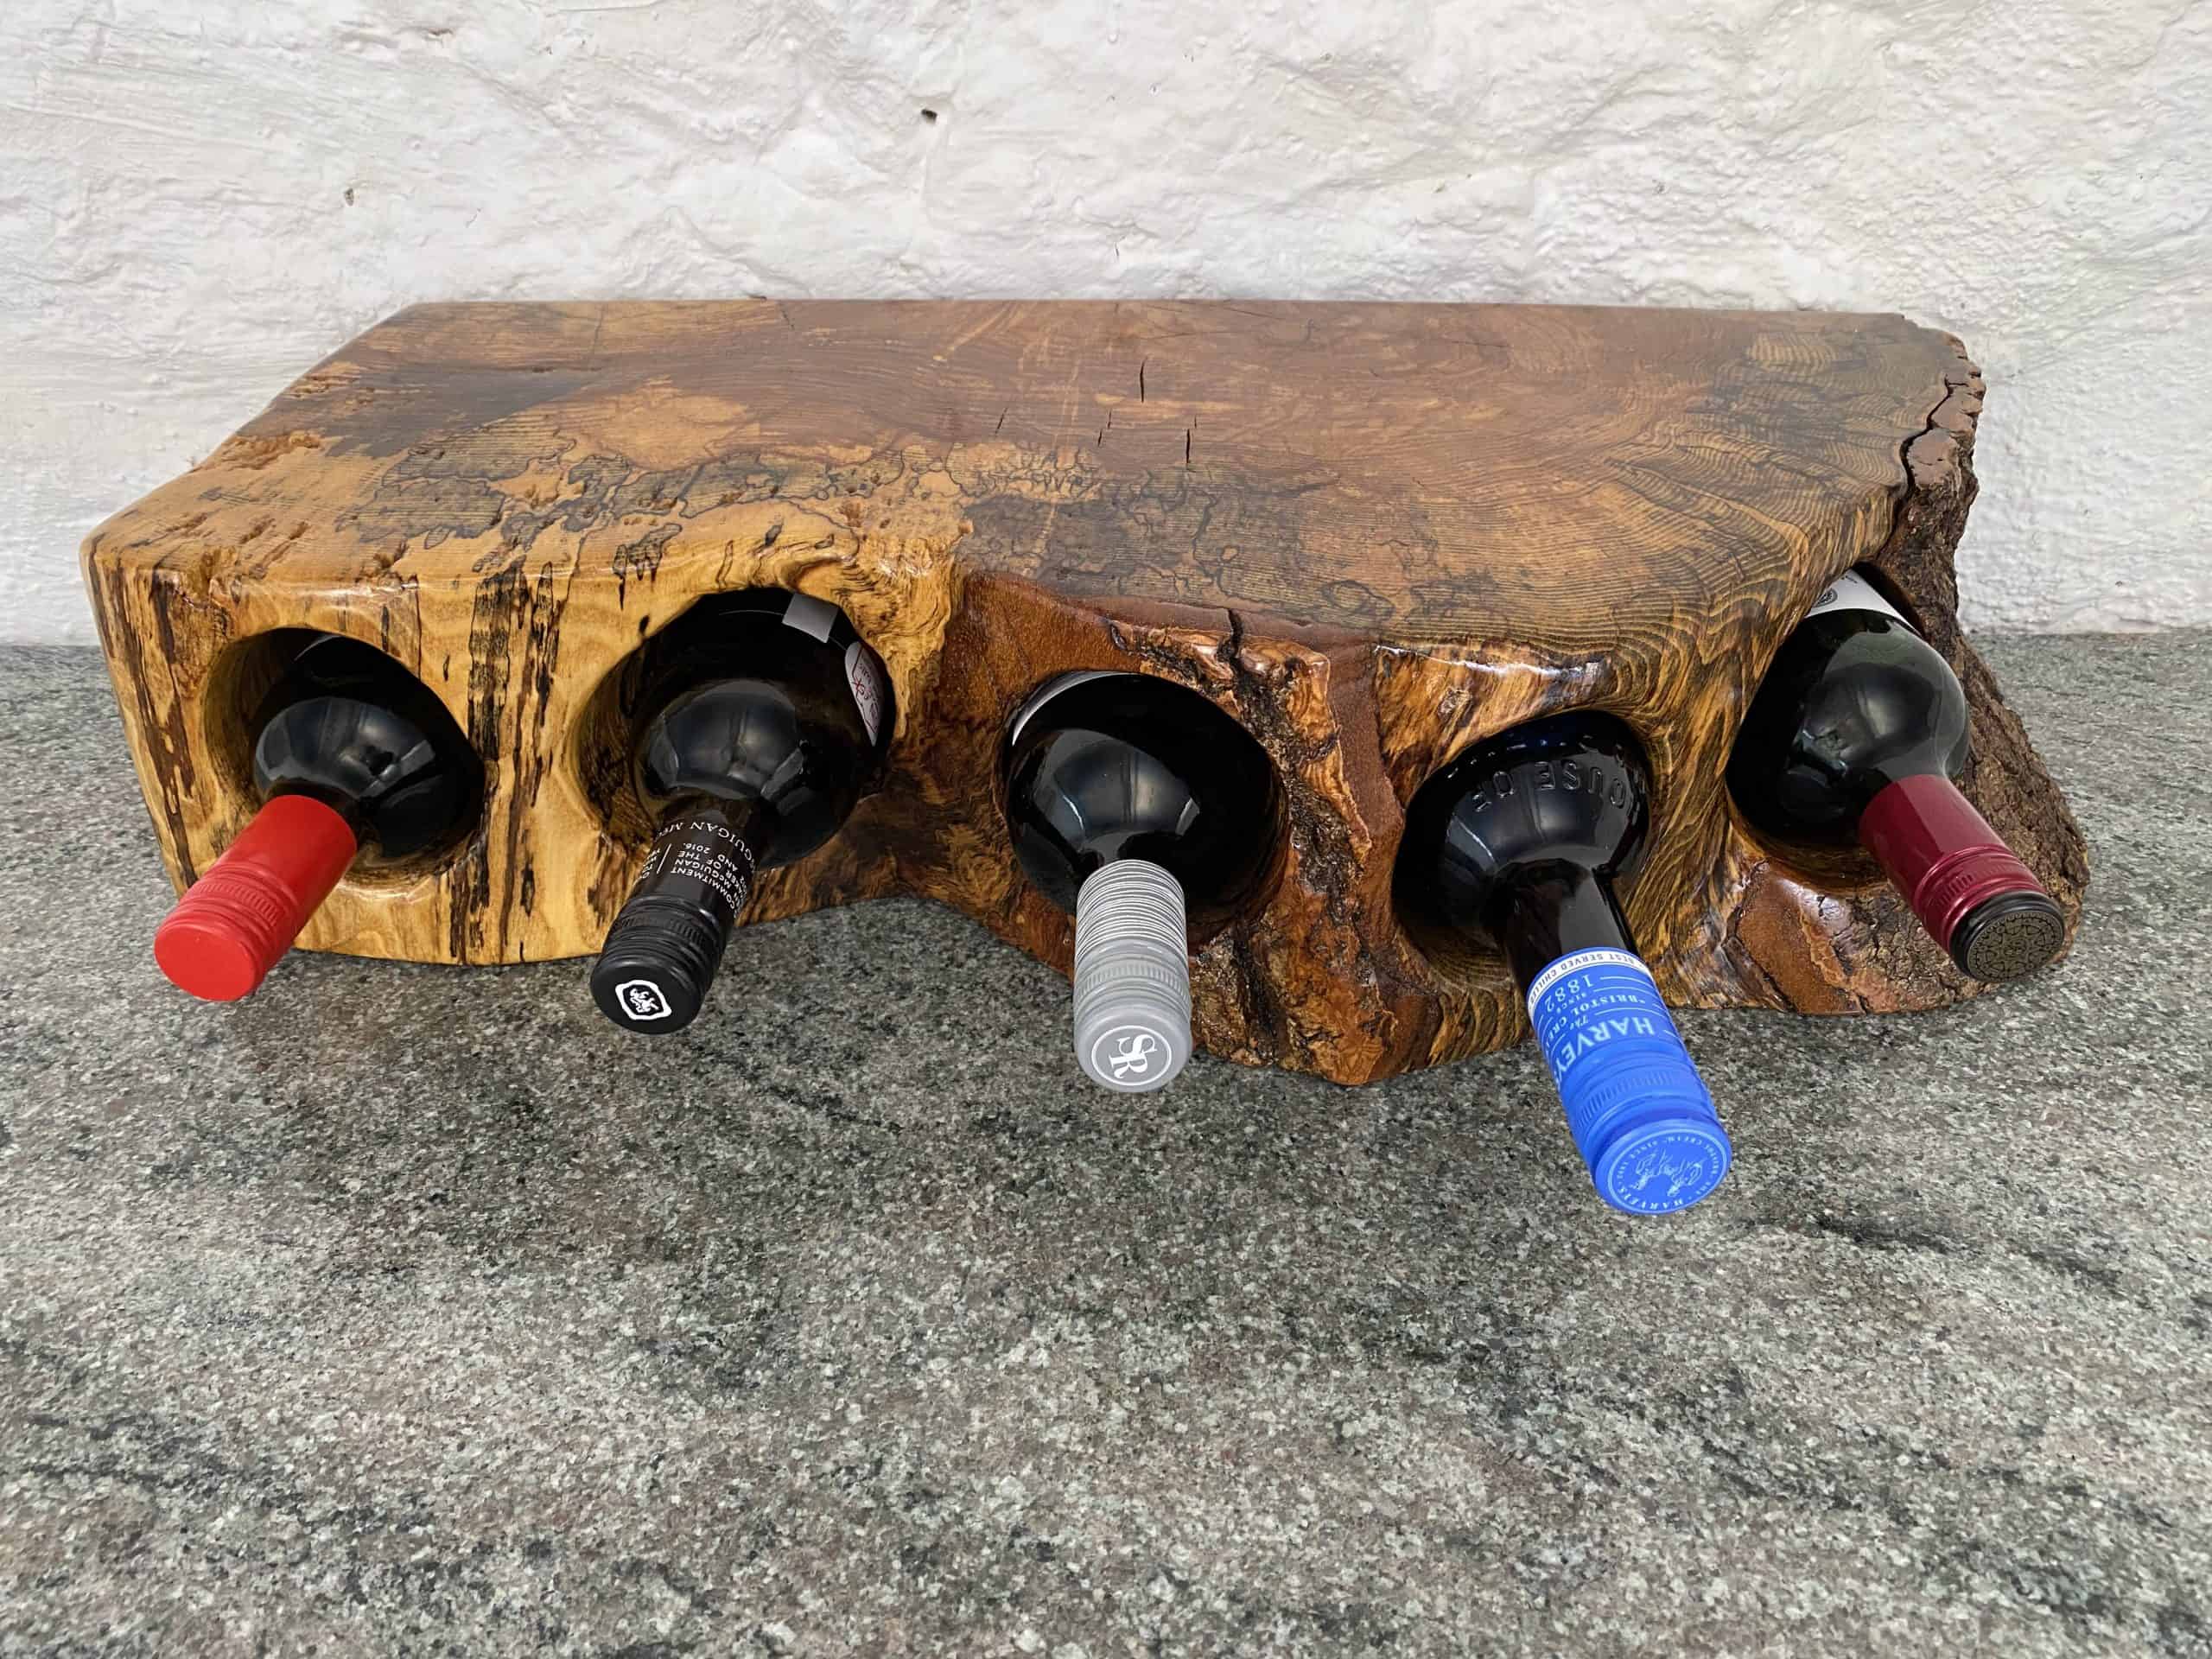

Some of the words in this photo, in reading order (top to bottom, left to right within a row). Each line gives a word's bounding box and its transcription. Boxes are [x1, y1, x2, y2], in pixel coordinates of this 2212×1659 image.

[677, 849, 701, 861] THE
[689, 822, 753, 868] GUIGAN
[671, 867, 735, 910] COMMITMENT
[1560, 952, 1605, 971] SERVED
[1545, 973, 1595, 1013] 1882
